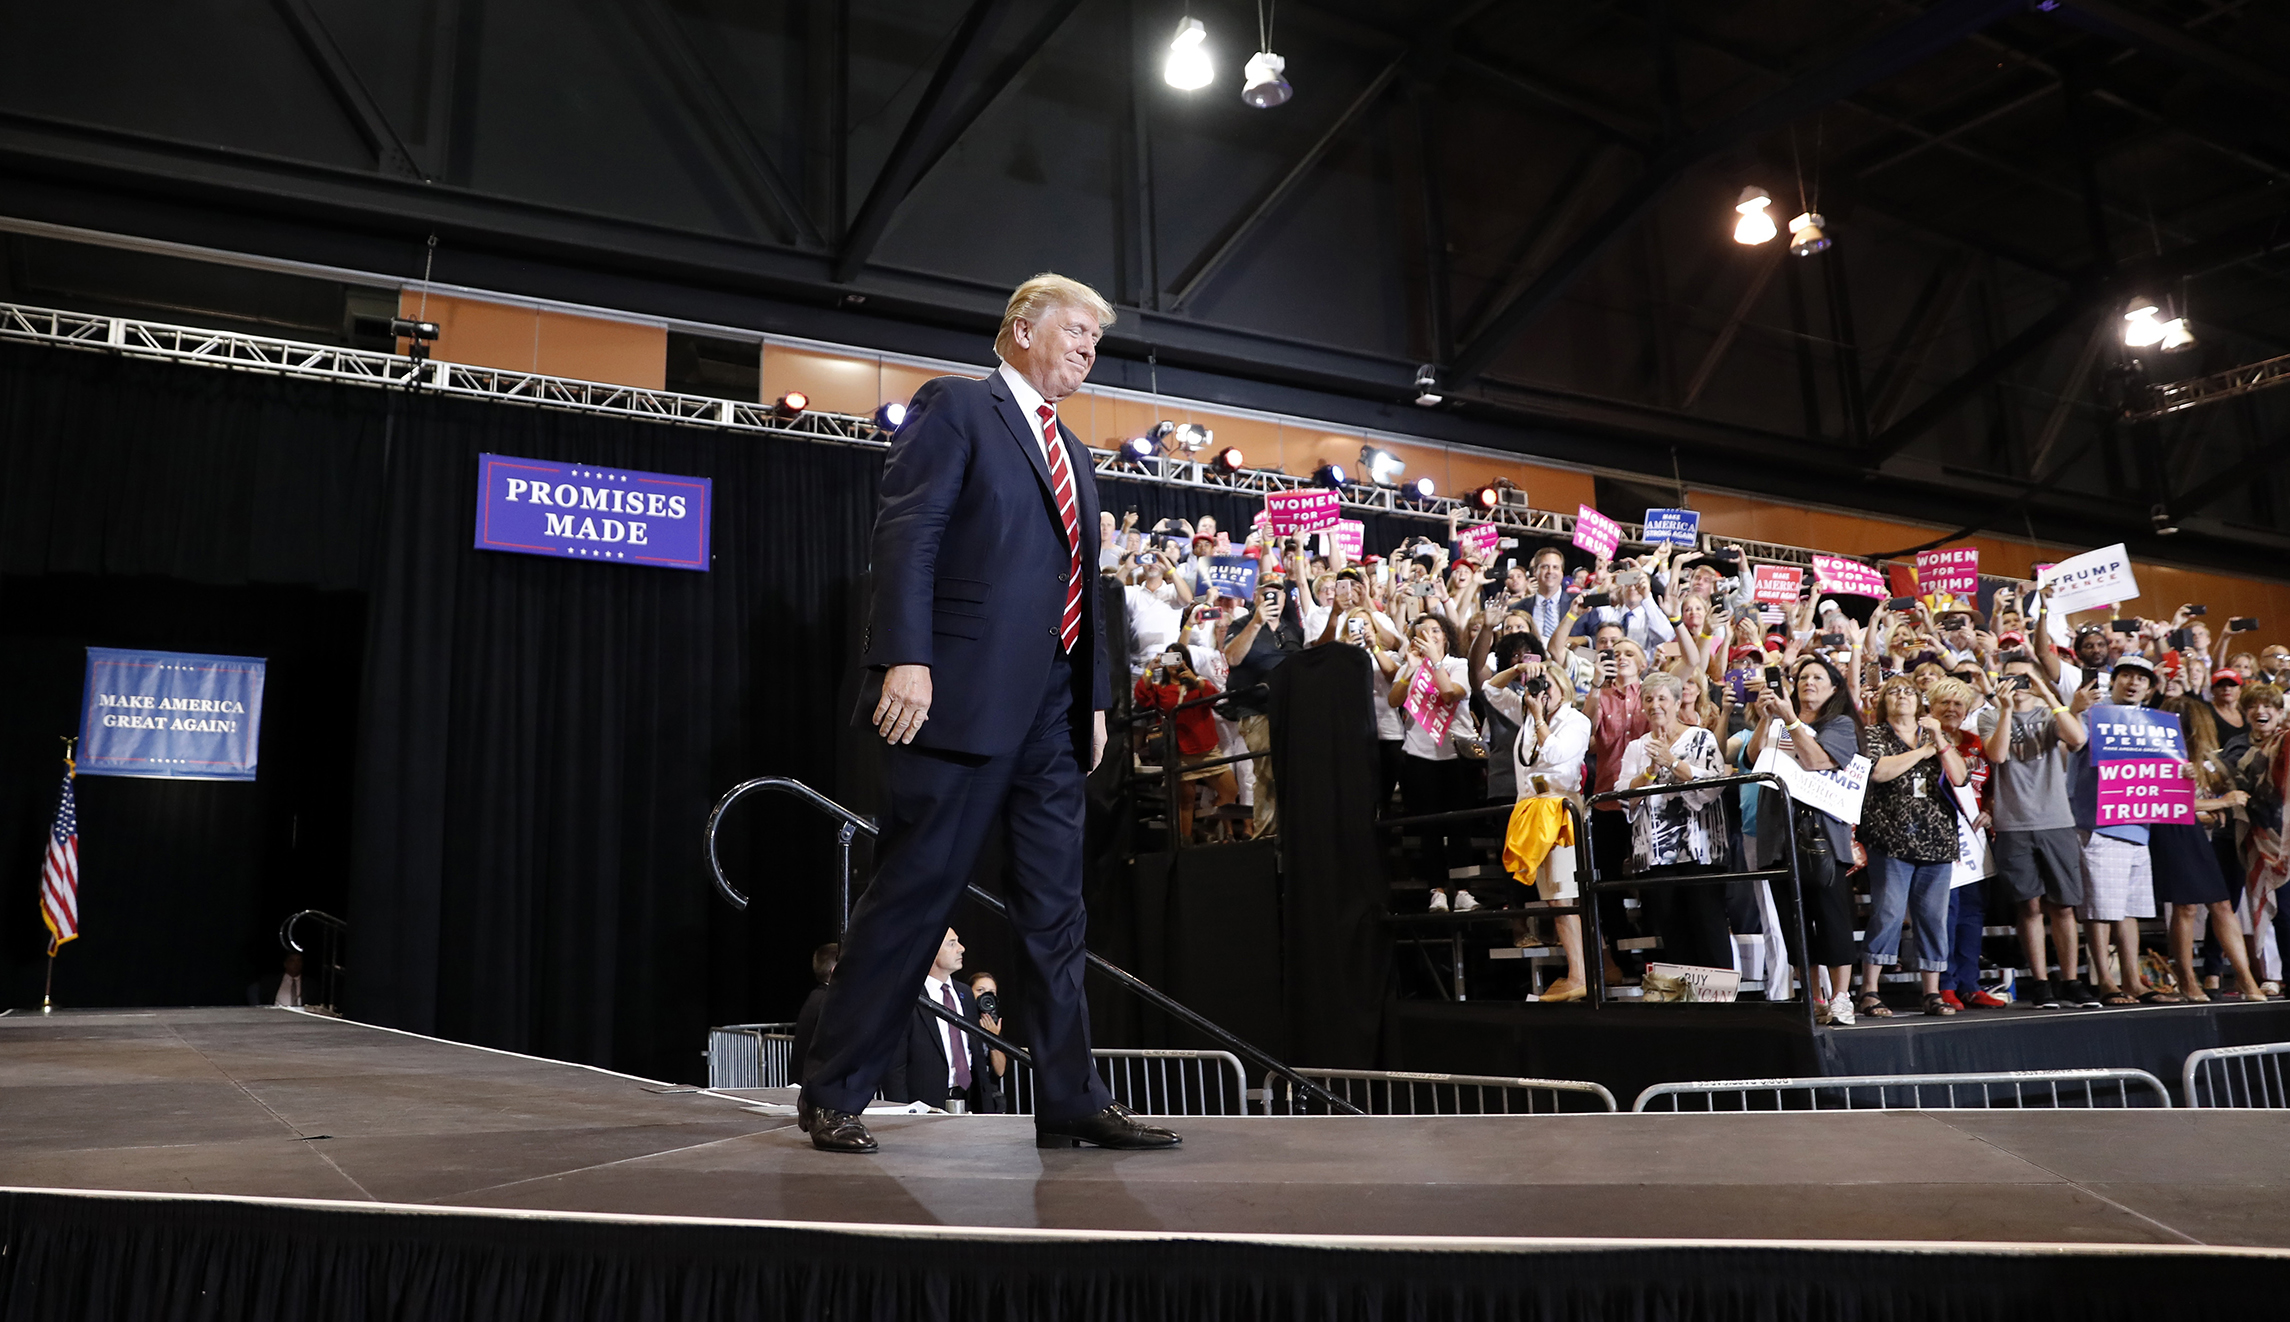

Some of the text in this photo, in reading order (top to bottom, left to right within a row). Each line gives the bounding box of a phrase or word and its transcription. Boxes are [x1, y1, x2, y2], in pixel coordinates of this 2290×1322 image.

[505, 477, 687, 520] PROMISES
[1270, 493, 1339, 510] WOMEN
[1293, 511, 1318, 521] FOR
[1580, 507, 1621, 539] WOMEN
[544, 512, 648, 545] MADE
[1276, 517, 1336, 533] TRUMP
[1647, 520, 1696, 532] AMERICA
[1591, 527, 1608, 541] FOR
[1577, 532, 1614, 558] TRUMP
[1917, 550, 1976, 567] WOMEN
[1209, 565, 1253, 576] RUMP
[1814, 558, 1882, 578] WOMEN
[1837, 571, 1863, 581] FOR
[1932, 567, 1955, 576] FOR
[2051, 561, 2120, 586] TRUMP
[1211, 573, 1247, 582] ENCE
[1920, 578, 1974, 593] TRUMP
[2059, 573, 2117, 592] PENCE
[99, 694, 245, 714] MAKE AMERICA
[1426, 687, 1440, 710] FOR
[103, 714, 237, 733] GREAT AGAIN!
[2096, 723, 2178, 739] TRUMP
[2105, 737, 2176, 747] PENCE
[1790, 770, 1845, 807] AMERICA
[2126, 785, 2160, 797] FOR
[2101, 803, 2188, 820] TRUMP
[1684, 973, 1708, 986] BUY
[1697, 987, 1732, 1002] ICAN
